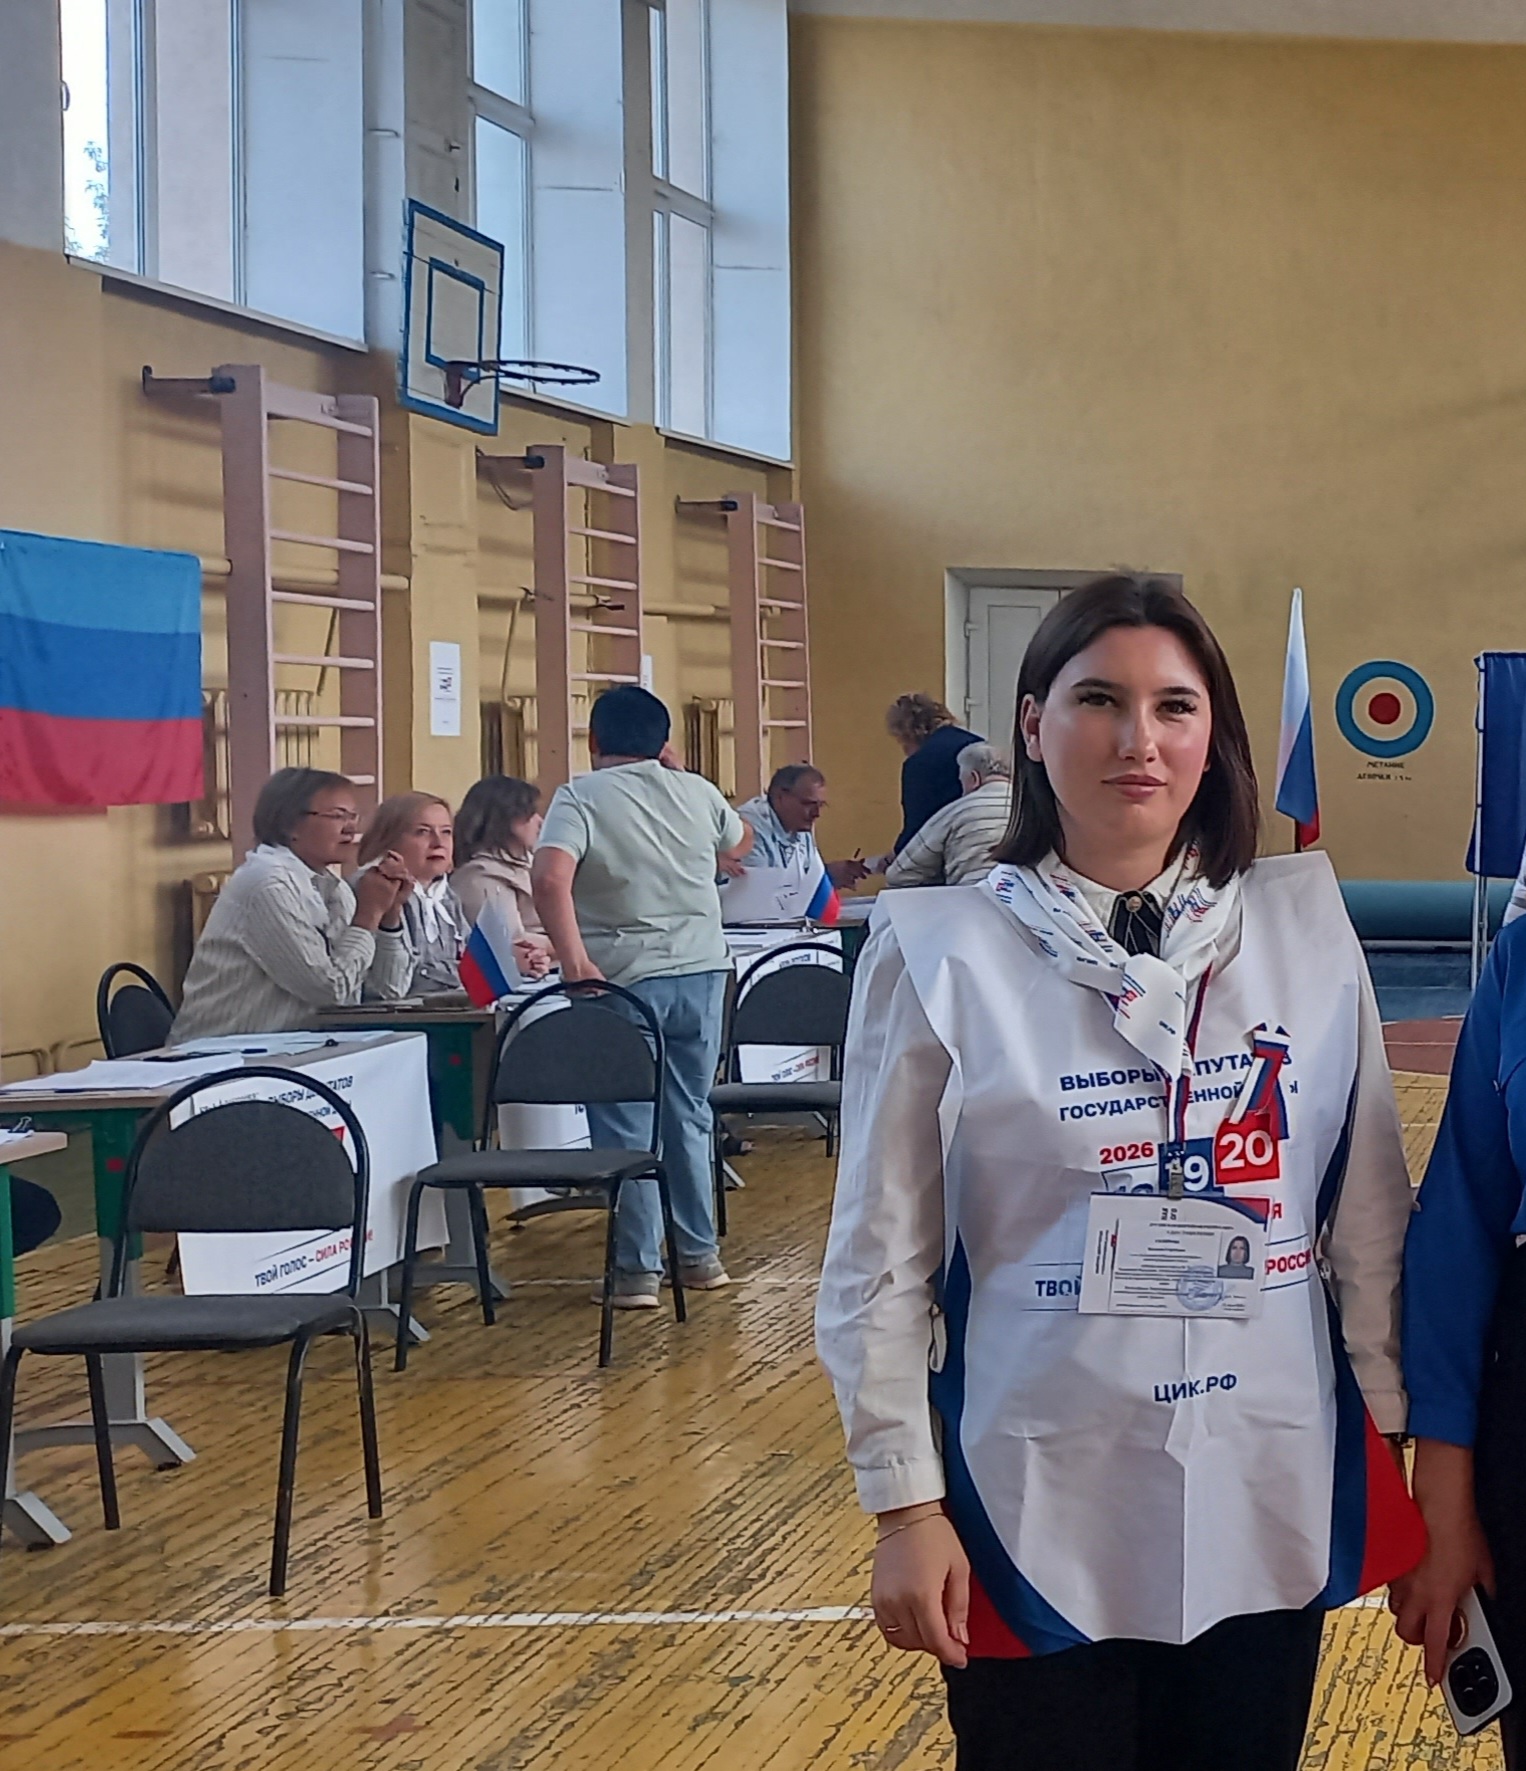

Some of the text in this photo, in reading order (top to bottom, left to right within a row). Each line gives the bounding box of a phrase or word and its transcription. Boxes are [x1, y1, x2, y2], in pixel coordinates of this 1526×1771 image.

[1060, 1068, 1161, 1092] ВЫБОРЫ
[1060, 1081, 1243, 1121] ГОСУДАРСТЕННОЙ
[1100, 1142, 1154, 1164] 2026
[1219, 1130, 1273, 1169] 20
[255, 1264, 278, 1287] ТВОЙ
[280, 1256, 307, 1276] ГОЛОС
[315, 1245, 337, 1262] СИЛА
[1265, 1248, 1311, 1275] РОСС
[1154, 1373, 1237, 1404] ЦИК.РФ
